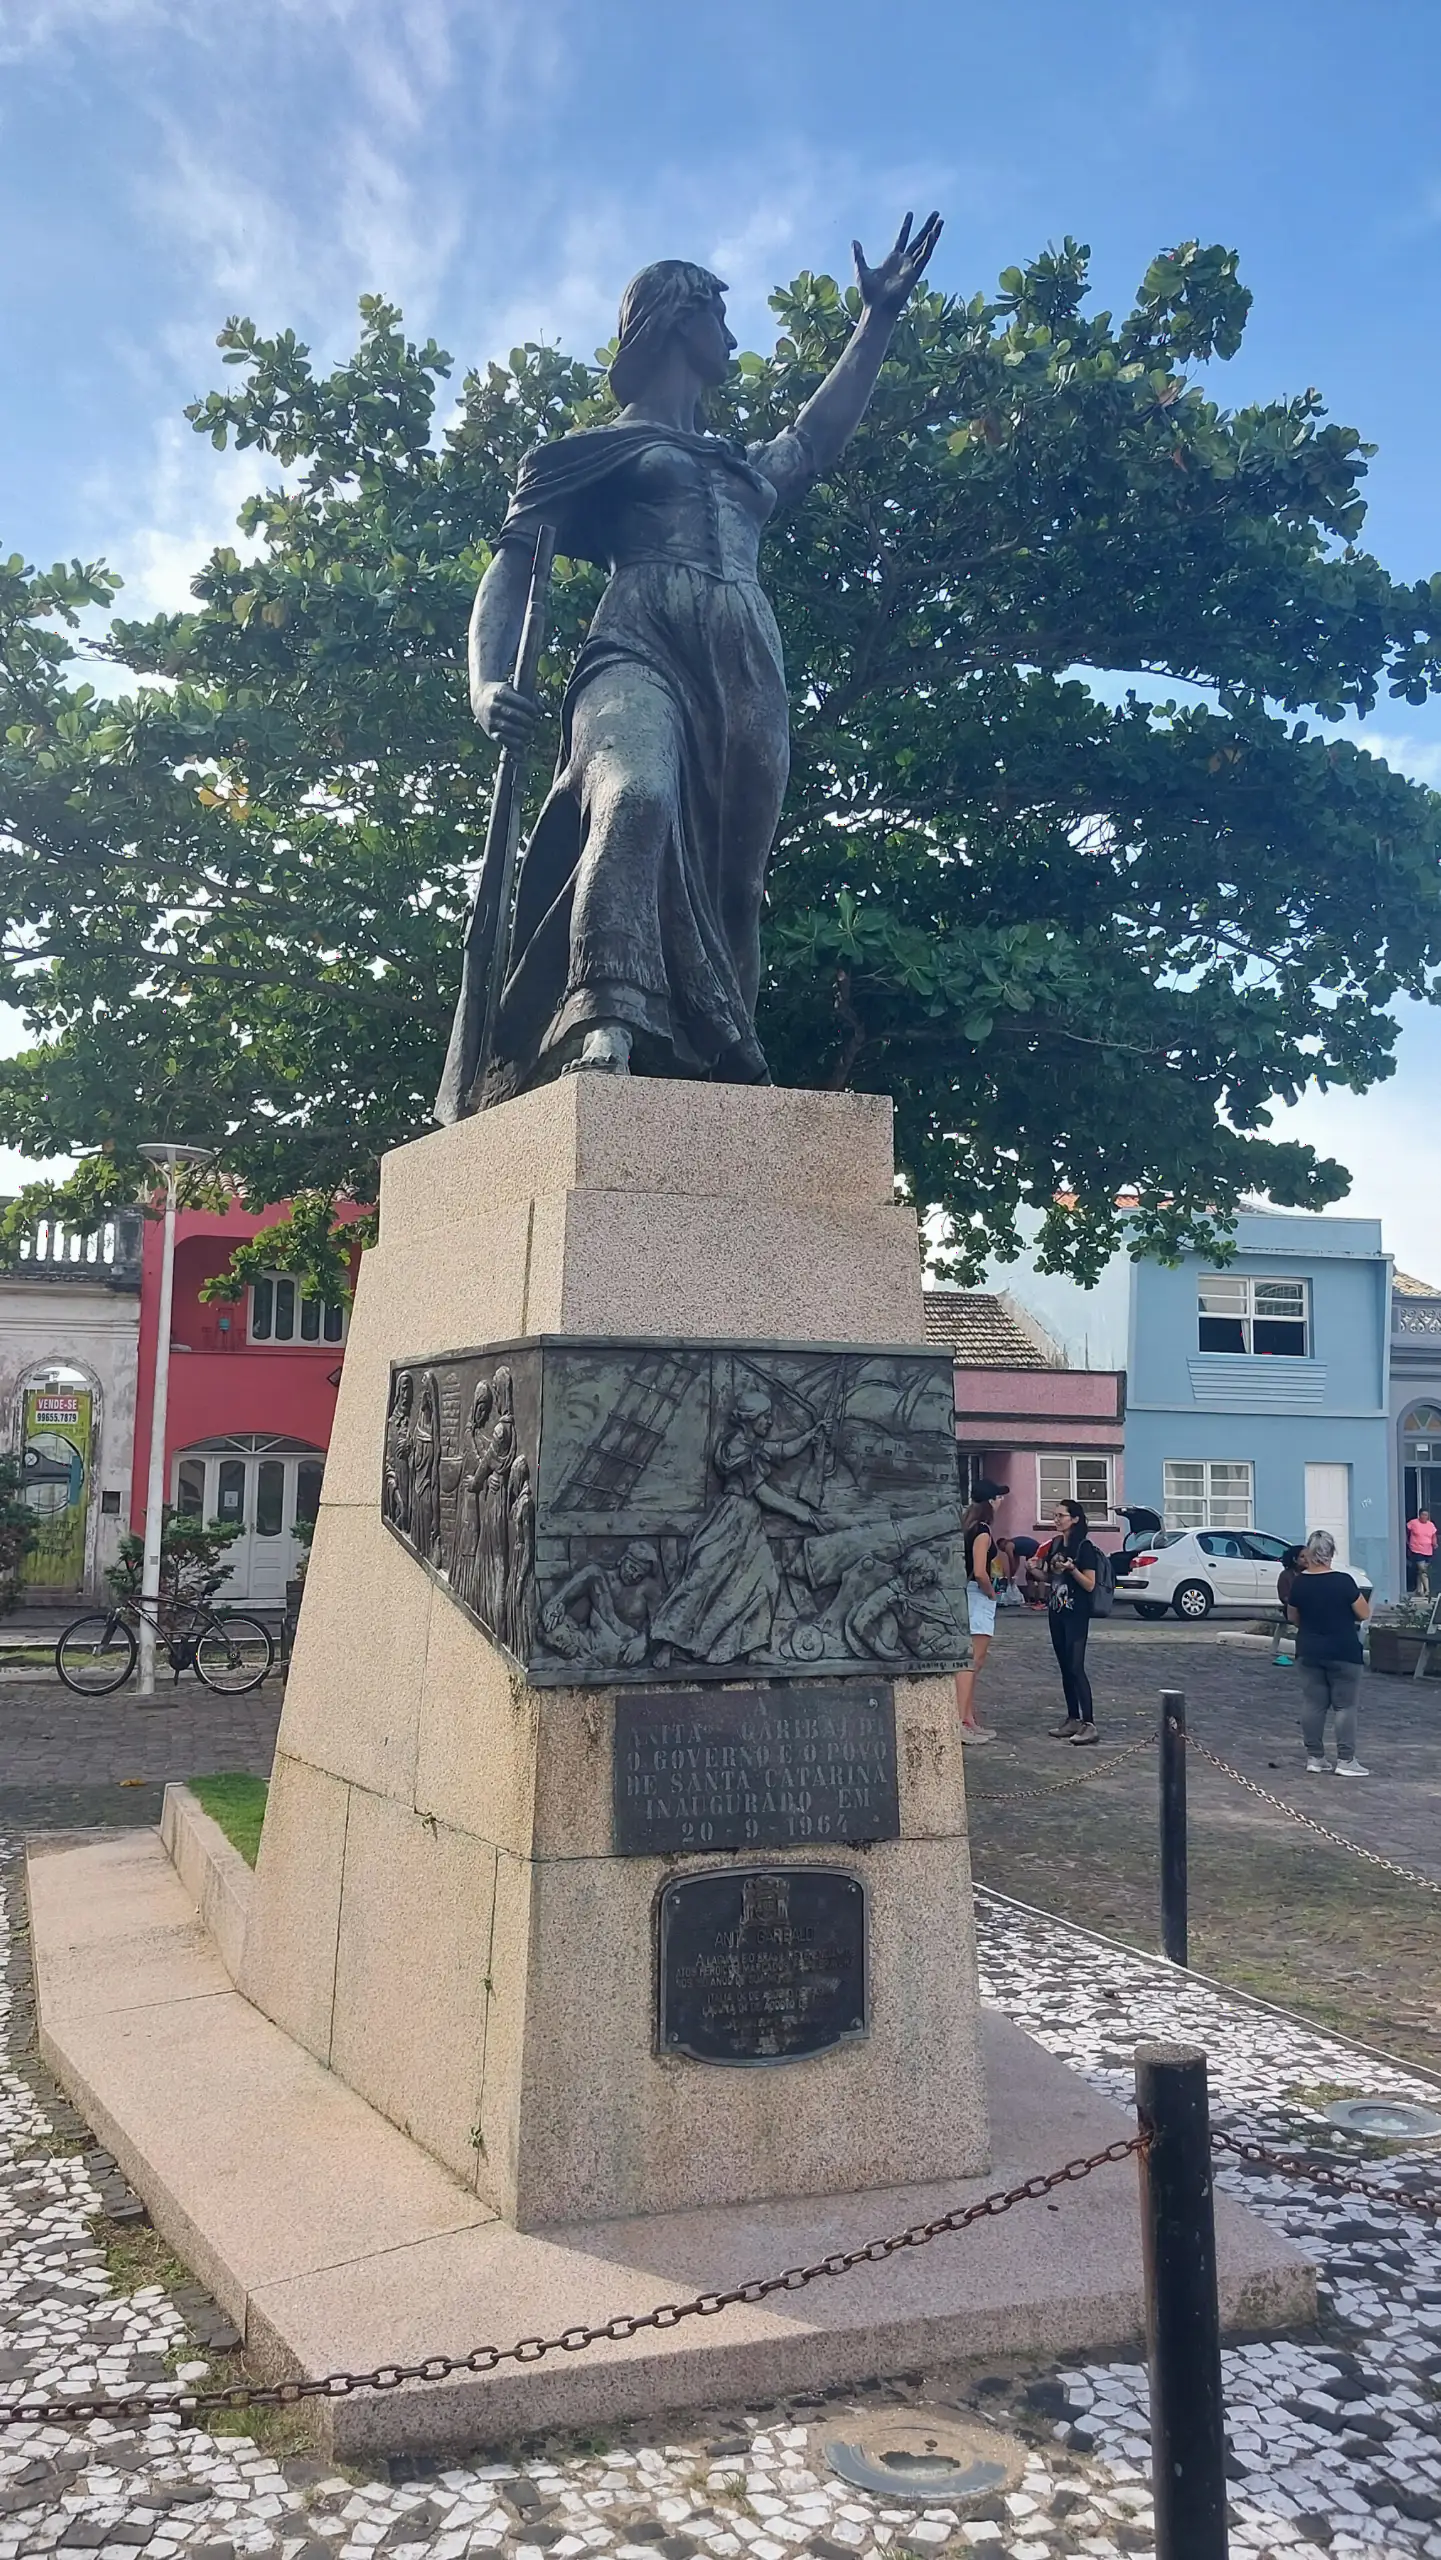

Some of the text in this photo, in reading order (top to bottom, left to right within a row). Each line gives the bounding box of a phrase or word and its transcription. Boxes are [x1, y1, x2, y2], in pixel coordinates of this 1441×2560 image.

[37, 1413, 77, 1422] 99655.7879
[38, 1399, 78, 1410] VENDE-SE
[754, 1697, 767, 1715] A
[629, 1722, 702, 1748] ANITA
[627, 1740, 887, 1771] O GOVERNO E O POVO
[627, 1764, 888, 1796] DE SANTA CATARINA
[646, 1787, 872, 1820] INAUGURADO EM
[682, 1821, 714, 1843] 20
[745, 1818, 759, 1839] 9
[787, 1814, 848, 1835] 1964
[714, 1929, 748, 1948] ANITA
